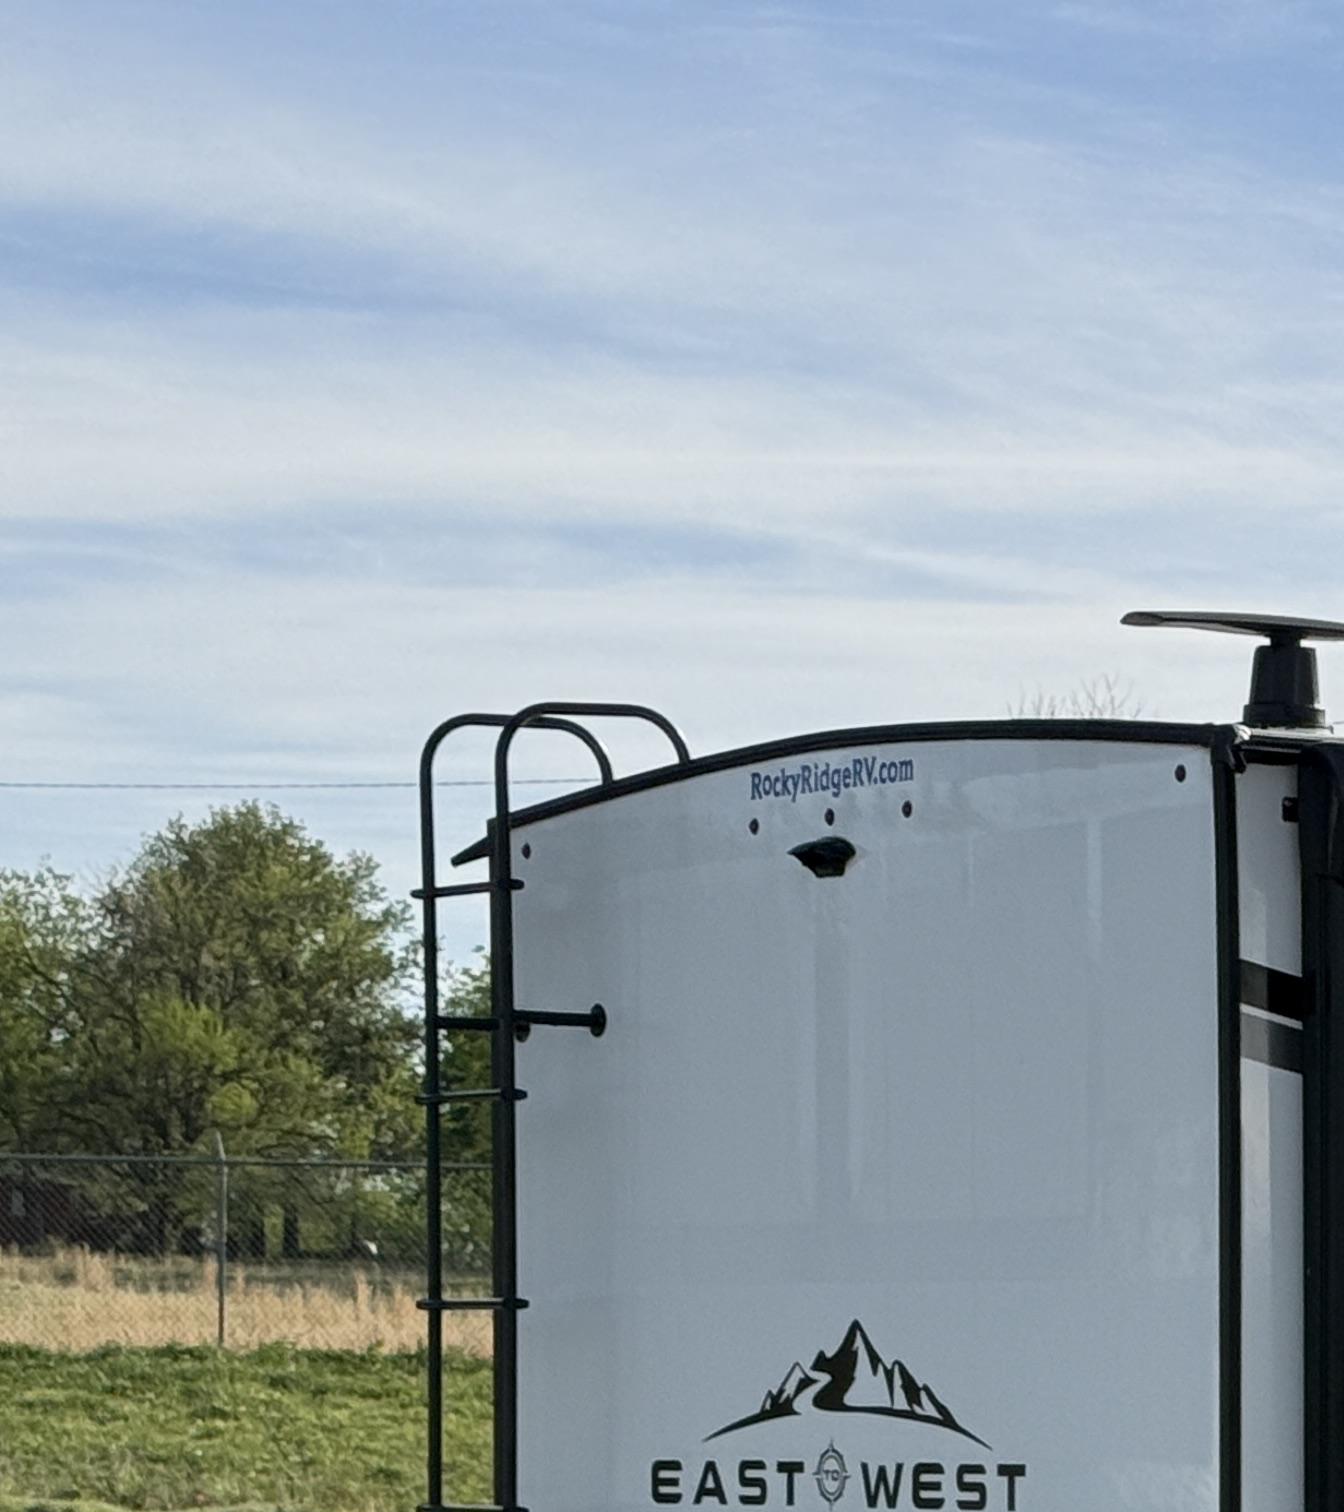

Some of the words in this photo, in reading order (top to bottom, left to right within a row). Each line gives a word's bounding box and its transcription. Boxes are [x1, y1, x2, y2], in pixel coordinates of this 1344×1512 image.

[751, 755, 914, 802] RockyRidgeRV.com
[651, 1459, 805, 1507] EAST
[861, 1462, 1026, 1511] WEST
